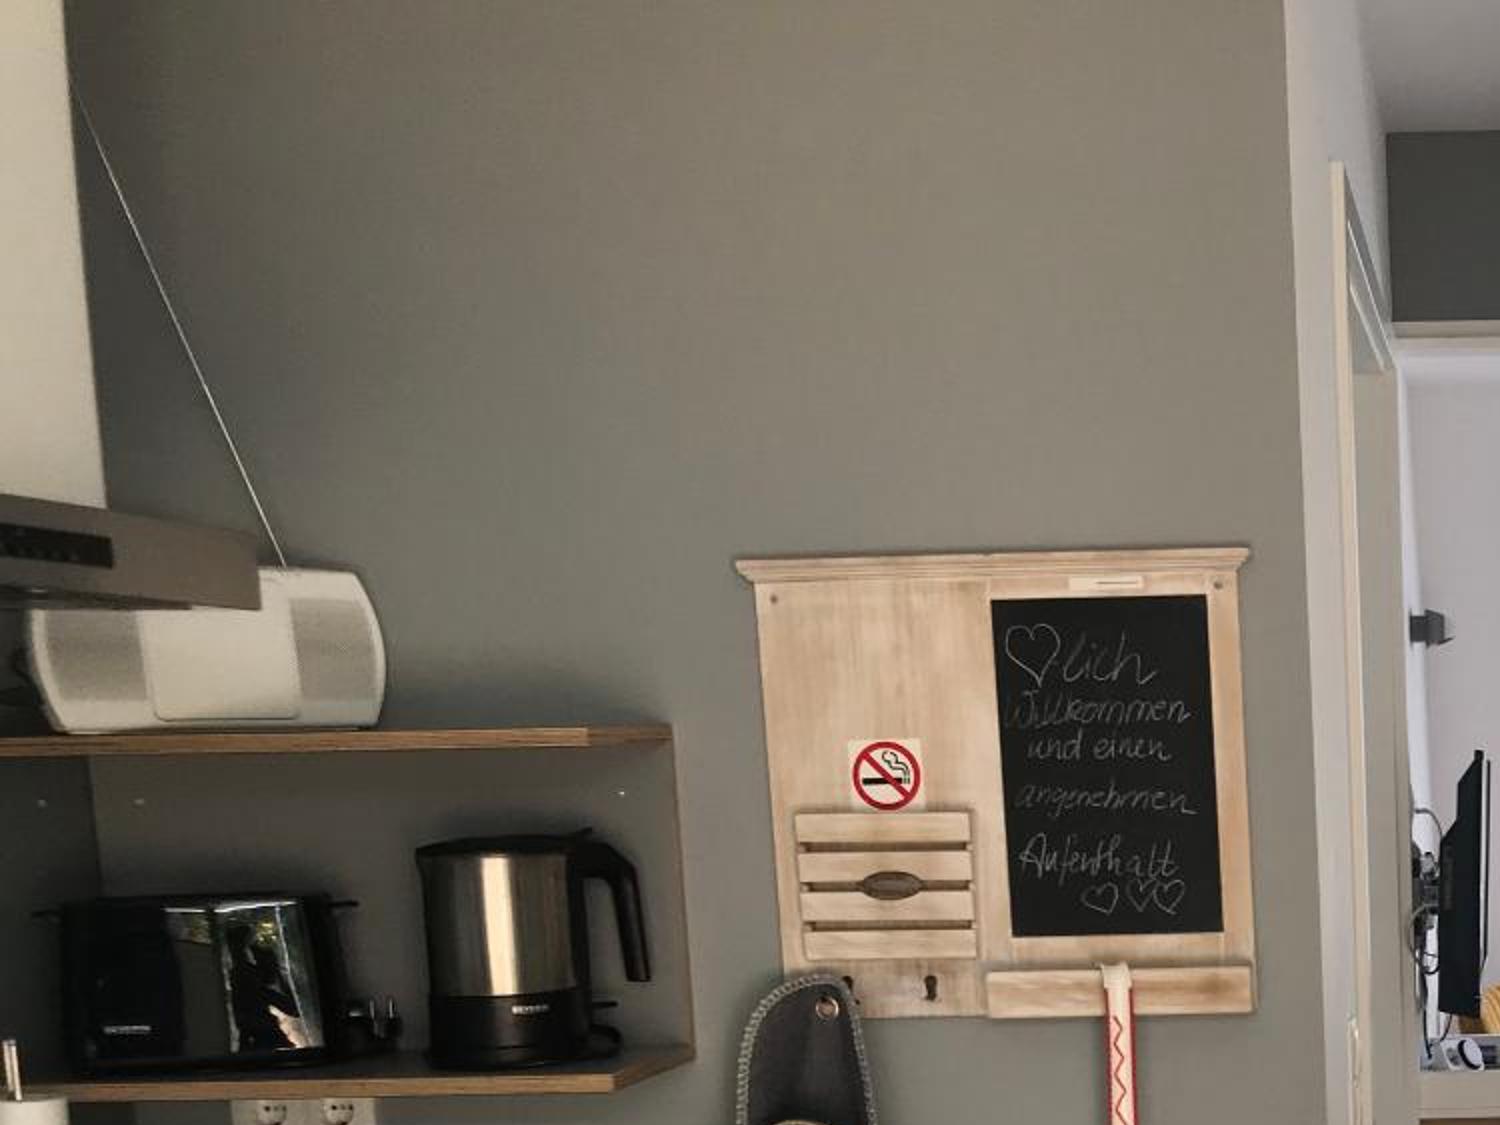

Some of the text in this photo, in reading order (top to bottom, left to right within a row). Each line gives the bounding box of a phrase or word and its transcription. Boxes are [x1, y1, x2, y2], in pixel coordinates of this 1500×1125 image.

[1063, 630, 1159, 685] lich
[1026, 727, 1173, 762] und einen
[1018, 832, 1180, 887] Aufenthalt
